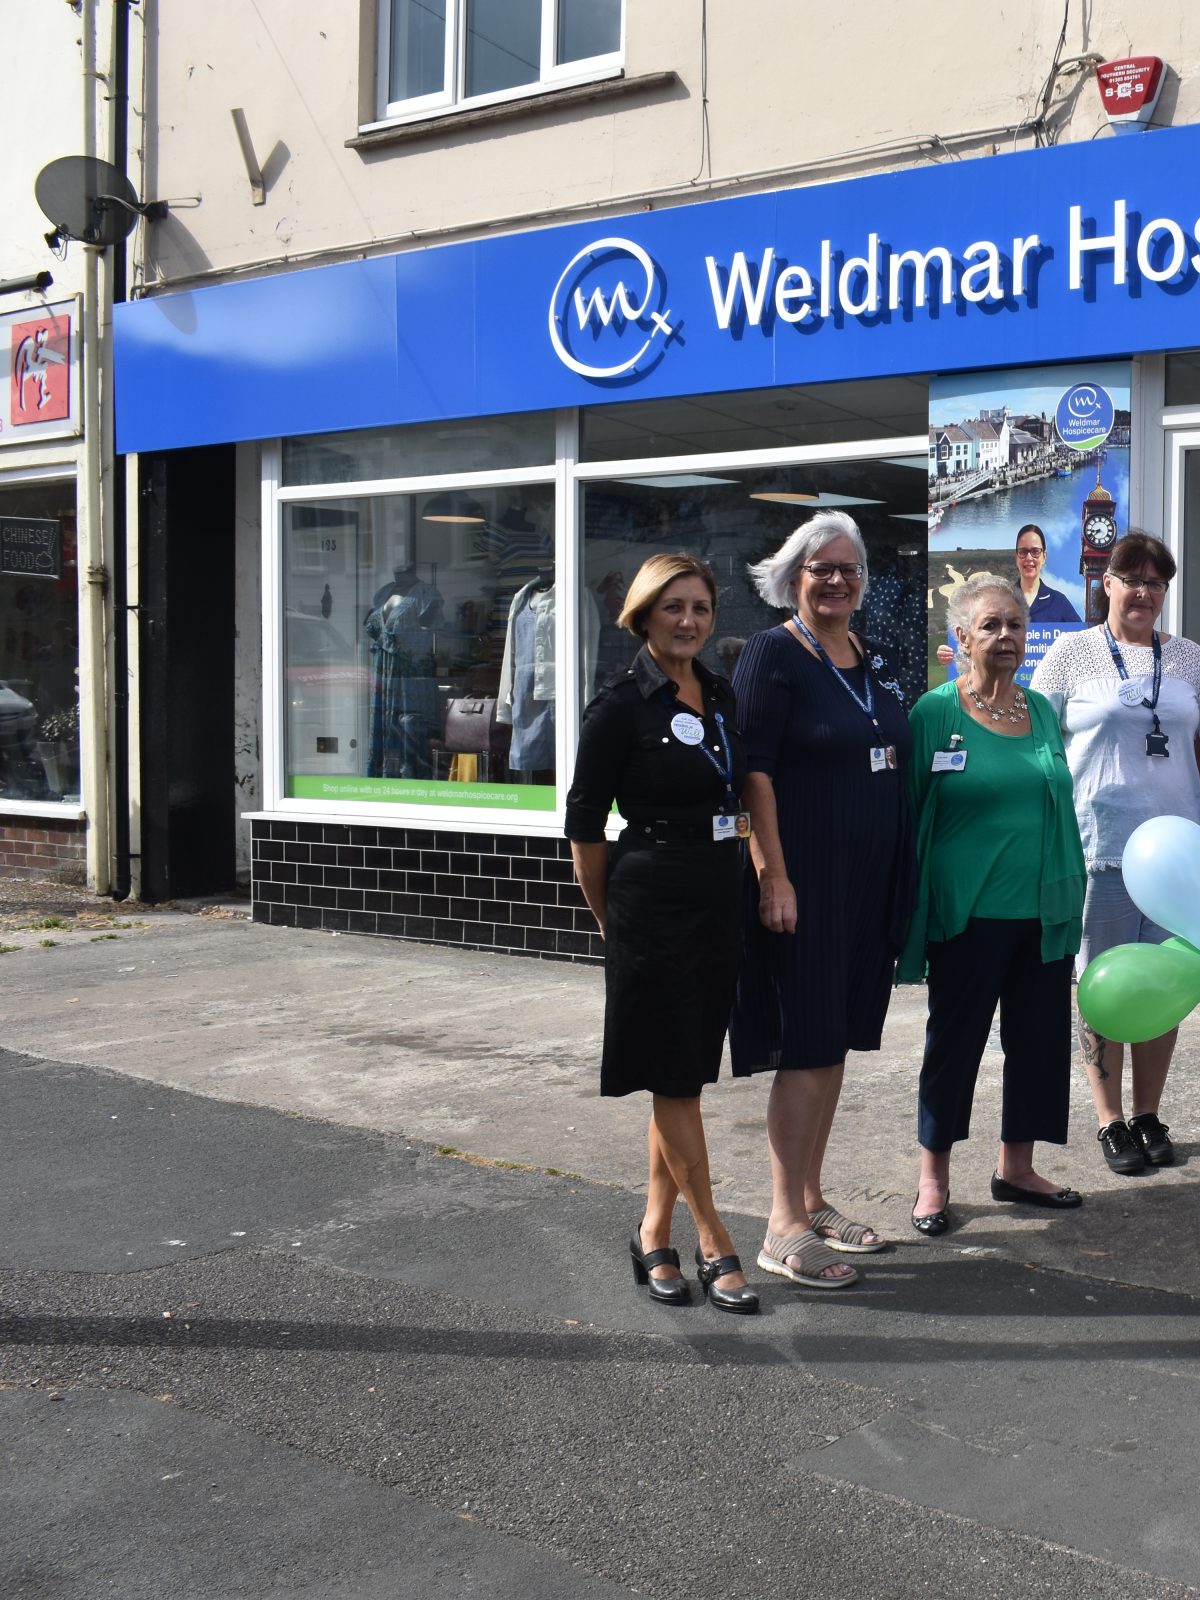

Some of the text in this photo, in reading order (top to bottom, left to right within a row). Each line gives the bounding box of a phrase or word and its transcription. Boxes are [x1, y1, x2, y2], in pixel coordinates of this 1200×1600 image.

[1126, 66, 1150, 74] SECURITY
[705, 233, 1039, 330] Weldmar
[1068, 418, 1101, 427] Weldmar
[1062, 427, 1107, 436] Hospicecare
[3, 527, 49, 545] CHINESE
[4, 550, 34, 570] FOOD
[1026, 629, 1040, 641] ple
[1042, 629, 1051, 639] in
[322, 783, 339, 794] Shop
[340, 785, 358, 793] online
[359, 785, 373, 794] with
[383, 786, 391, 794] 24
[392, 786, 410, 795] hours
[416, 787, 428, 798] day
[429, 789, 437, 797] at
[437, 788, 519, 802] weldmarhospicecare.org
